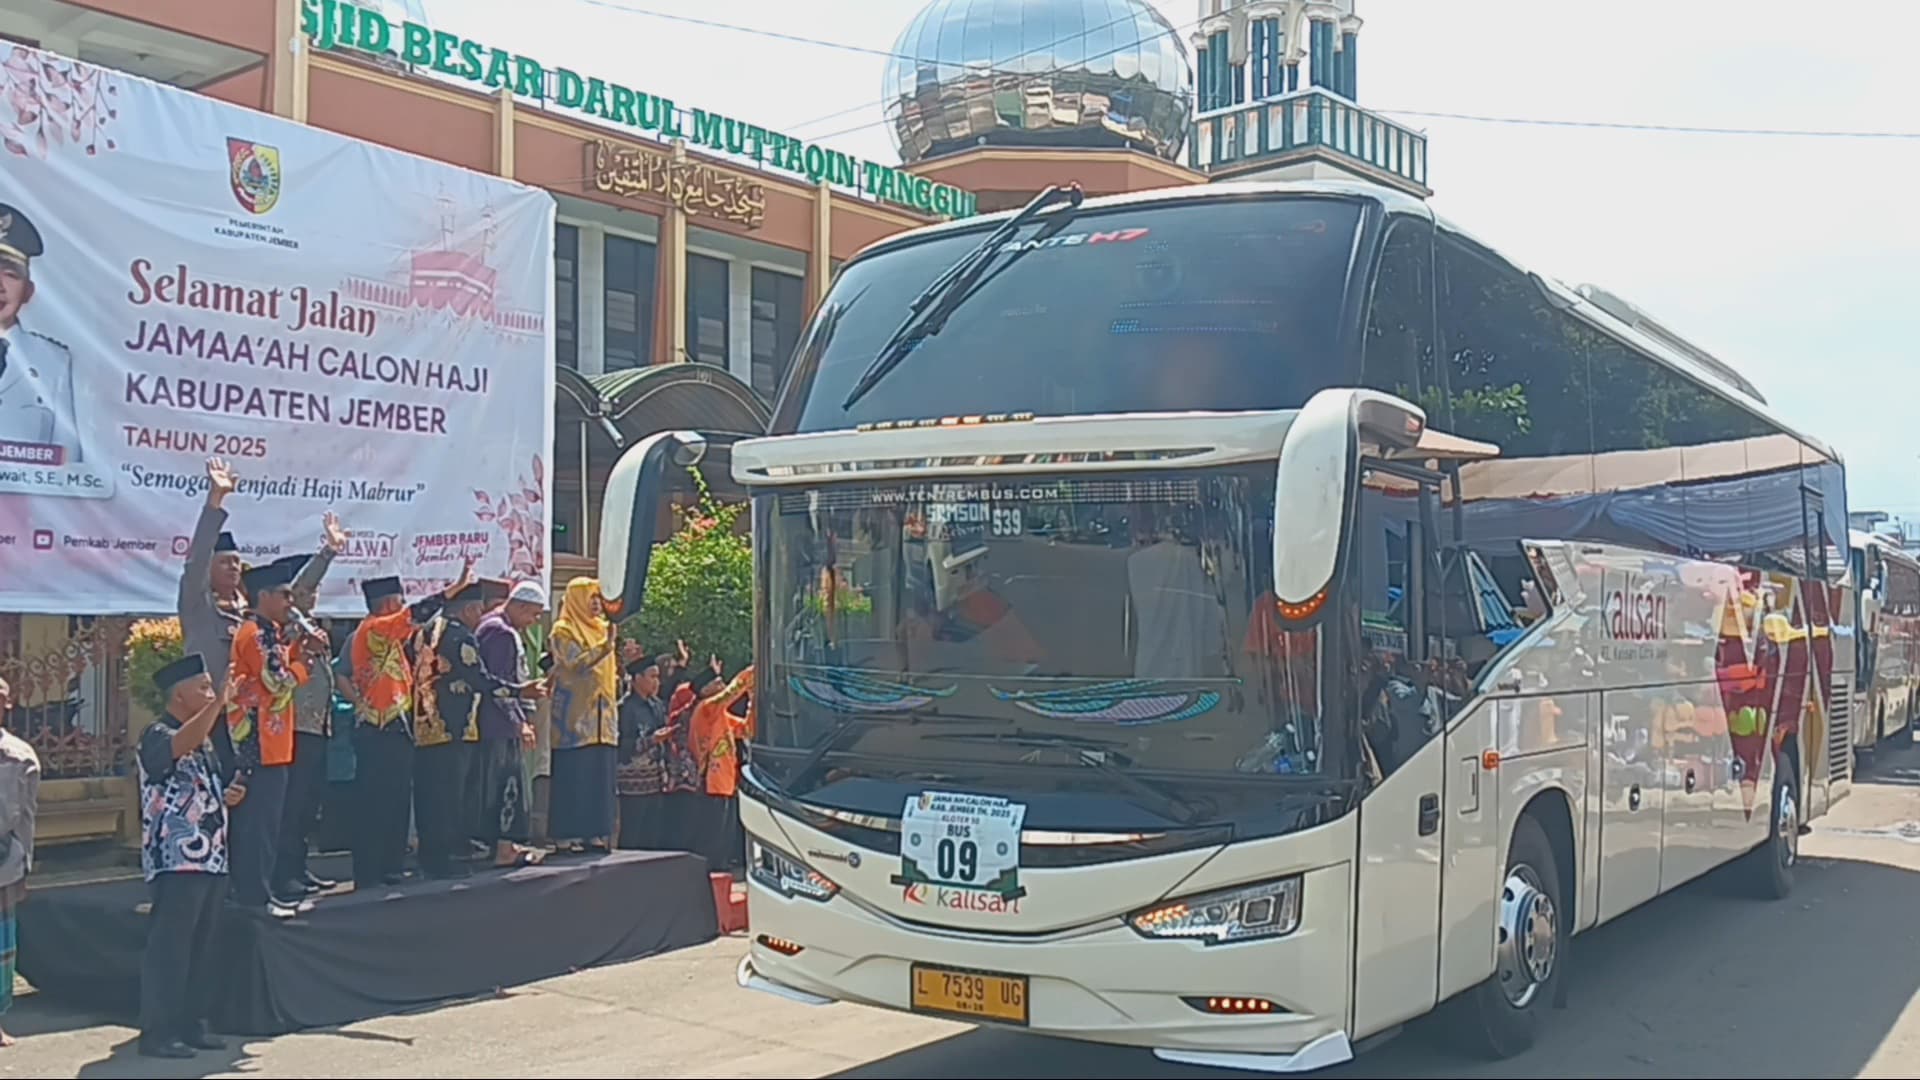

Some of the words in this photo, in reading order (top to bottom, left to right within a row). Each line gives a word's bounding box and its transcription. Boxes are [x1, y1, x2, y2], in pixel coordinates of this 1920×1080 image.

[401, 20, 543, 98] BESAR
[555, 67, 682, 136] DARUL
[691, 108, 855, 187] MUTTAQIN
[214, 227, 267, 242] KABUPATEN
[269, 236, 299, 249] JEMBER
[128, 258, 284, 319] Selamat
[287, 286, 376, 337] Jalan
[125, 320, 309, 372] JAMAA'AH
[318, 347, 420, 386] CALON
[425, 362, 488, 393] HAJI
[125, 372, 330, 423] KABUPATEN
[339, 398, 447, 434] JEMBER
[0, 445, 54, 461] JEMBER
[123, 426, 207, 453] TAHUN
[213, 434, 267, 457] 2025
[230, 474, 297, 501] enjadi
[301, 477, 343, 506] Haji
[992, 508, 1021, 536] 539
[64, 535, 109, 549] Pemkab
[114, 538, 157, 551] Jember
[412, 534, 456, 548] JEMBER
[459, 532, 489, 544] BARU
[990, 808, 1011, 818] 2025
[946, 824, 971, 838] BUS
[937, 838, 978, 882] 09
[917, 971, 929, 995] L
[942, 973, 984, 1000] 7539
[1001, 981, 1021, 1006] UG
